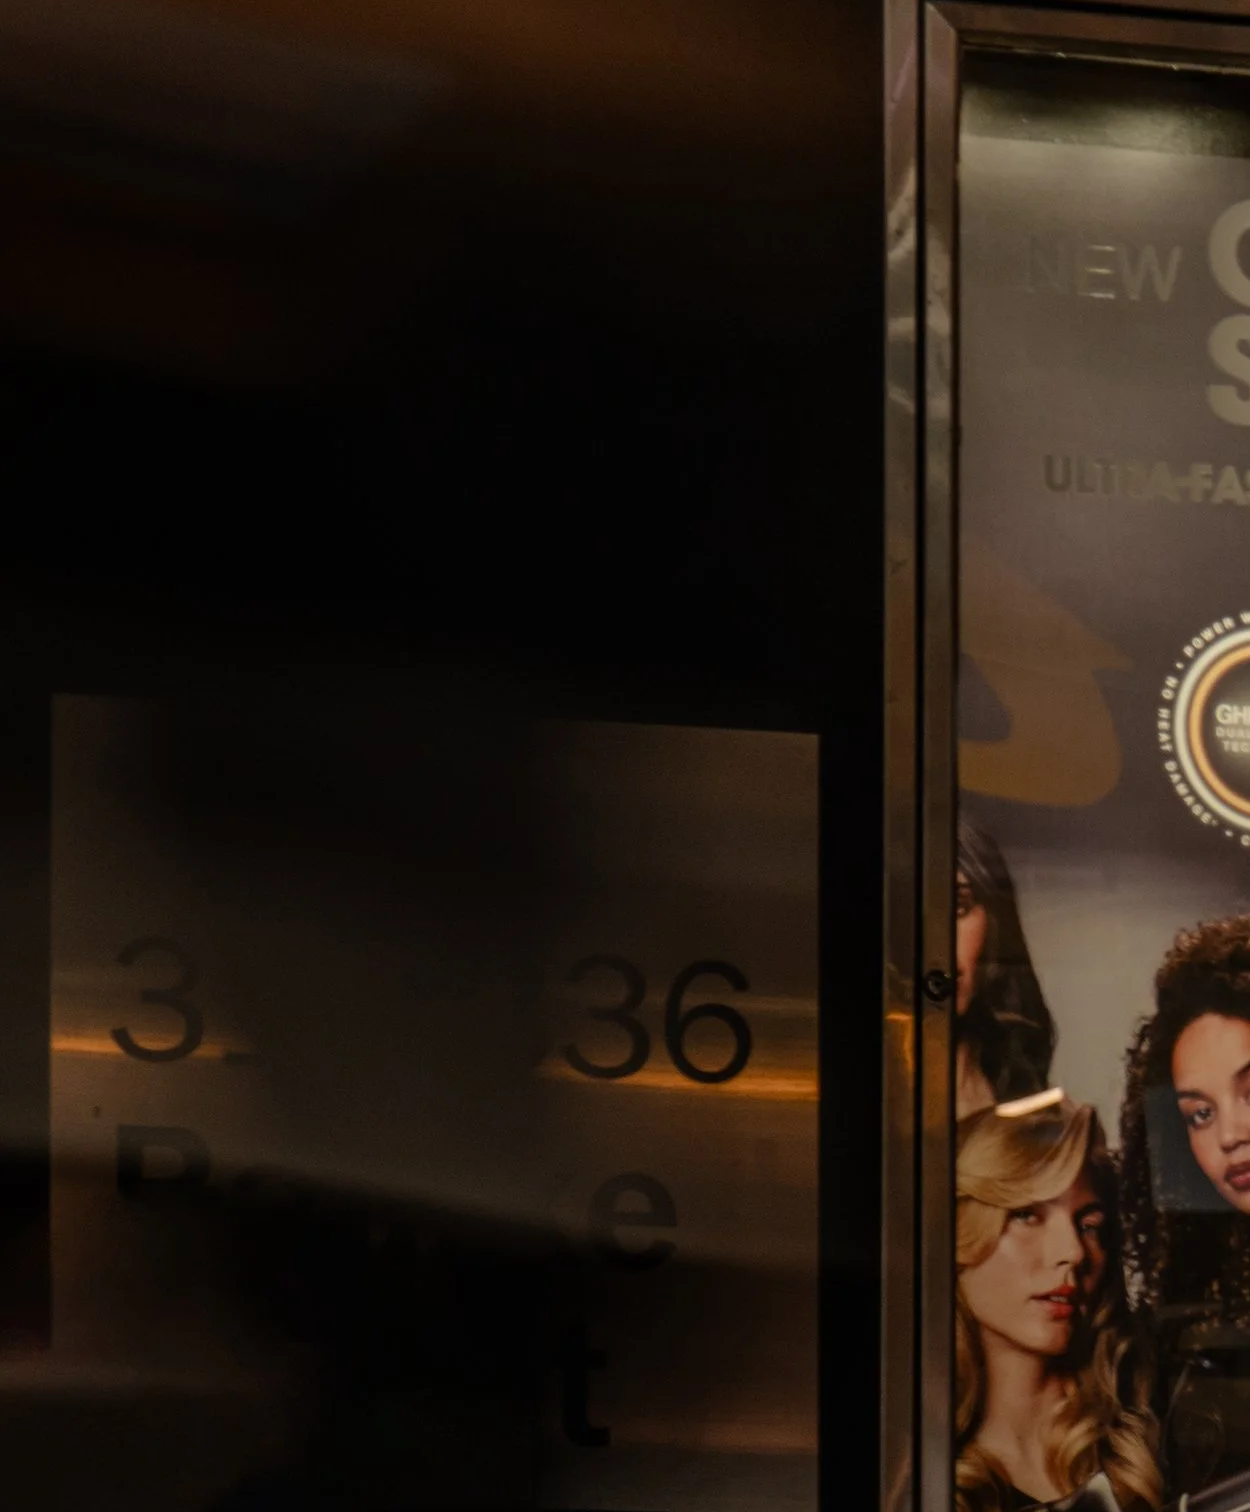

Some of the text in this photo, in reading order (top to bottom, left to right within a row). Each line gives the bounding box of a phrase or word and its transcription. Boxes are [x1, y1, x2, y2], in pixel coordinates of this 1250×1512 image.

[1026, 236, 1182, 302] NEW
[1183, 617, 1236, 659] POWER
[1157, 707, 1173, 752] HEAT
[562, 953, 754, 1085] 36
